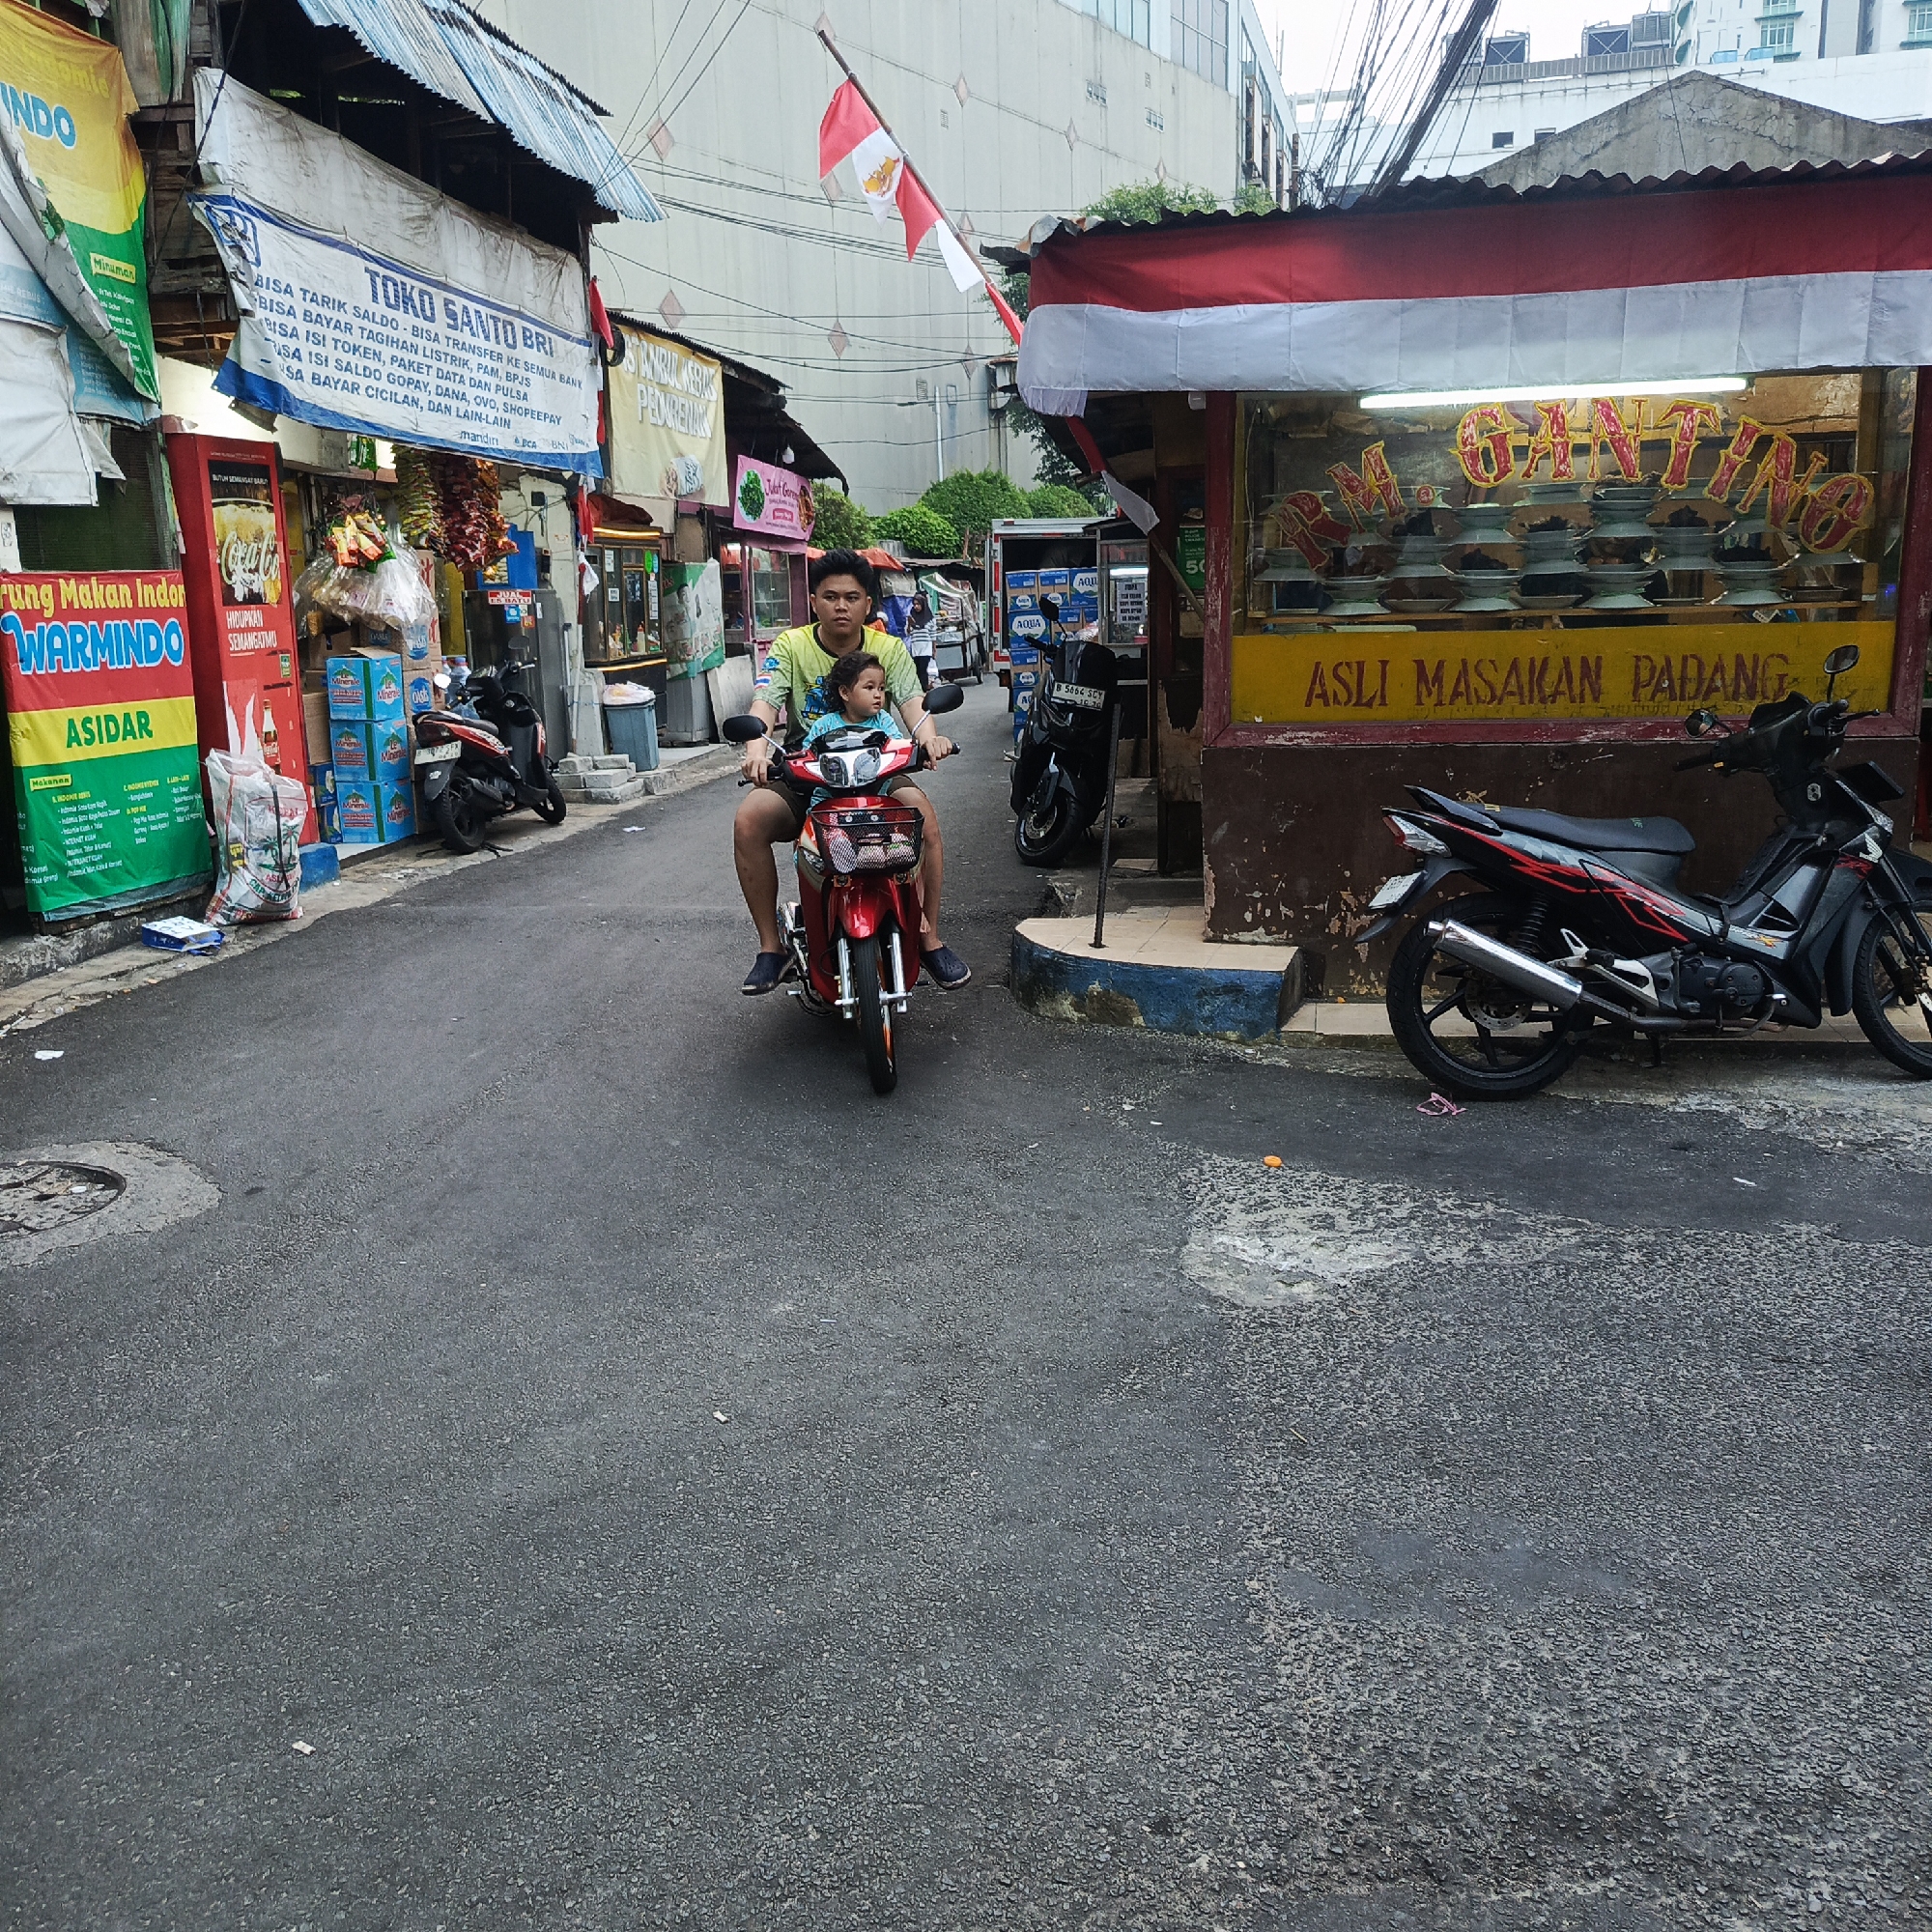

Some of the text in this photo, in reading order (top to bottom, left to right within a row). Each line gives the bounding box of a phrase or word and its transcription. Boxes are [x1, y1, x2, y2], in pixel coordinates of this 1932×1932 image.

[94, 257, 134, 280] Minuman
[364, 267, 554, 357] TOKO SANTO BRI
[254, 273, 294, 298] BISA
[299, 287, 348, 314] TARIK
[353, 305, 399, 331] SALDO
[412, 326, 440, 345] BISA
[445, 336, 503, 364] TRANSFER
[507, 355, 521, 369] KE
[524, 360, 556, 382] SEMUA
[559, 374, 583, 390] BANK
[303, 309, 354, 335] BAYAR
[358, 326, 418, 355] TAGIHAN
[422, 347, 473, 374] LISTRIK,
[476, 362, 502, 382] PAM,
[505, 371, 532, 388] BPJS
[264, 317, 529, 403] BISA ISI TOKEN, PAKET DATA DAN PULSA
[308, 351, 329, 368] ISI
[334, 358, 383, 381] SALDO
[386, 373, 432, 393] GOPAY,
[435, 384, 470, 406] DANA,
[473, 395, 499, 412] OVO,
[502, 402, 562, 426] SHOPEEPAY
[311, 372, 360, 395] BAYAR
[364, 384, 424, 413] CICILAN,
[427, 399, 452, 416] DAN
[456, 408, 511, 429] LAIN-LAIN
[522, 438, 537, 449] BCA
[1449, 397, 1874, 554] GANTINO
[59, 577, 133, 610] Makan
[226, 610, 264, 630] HIDUPKAN
[1016, 619, 1041, 629] AQUA
[0, 611, 185, 675] WARMINDO
[228, 631, 277, 651] SEMANGATMU
[385, 678, 392, 689] Le
[1065, 685, 1085, 696] 5664
[1305, 653, 1790, 709] ASLI MASAKAN PADANG
[377, 689, 401, 702] Minerale
[67, 710, 154, 749] ASIDAR
[381, 749, 407, 762] Minerale
[390, 739, 398, 751] Le
[32, 777, 70, 787] Makanan
[387, 807, 412, 822] Minerale
[394, 799, 402, 810] Le
